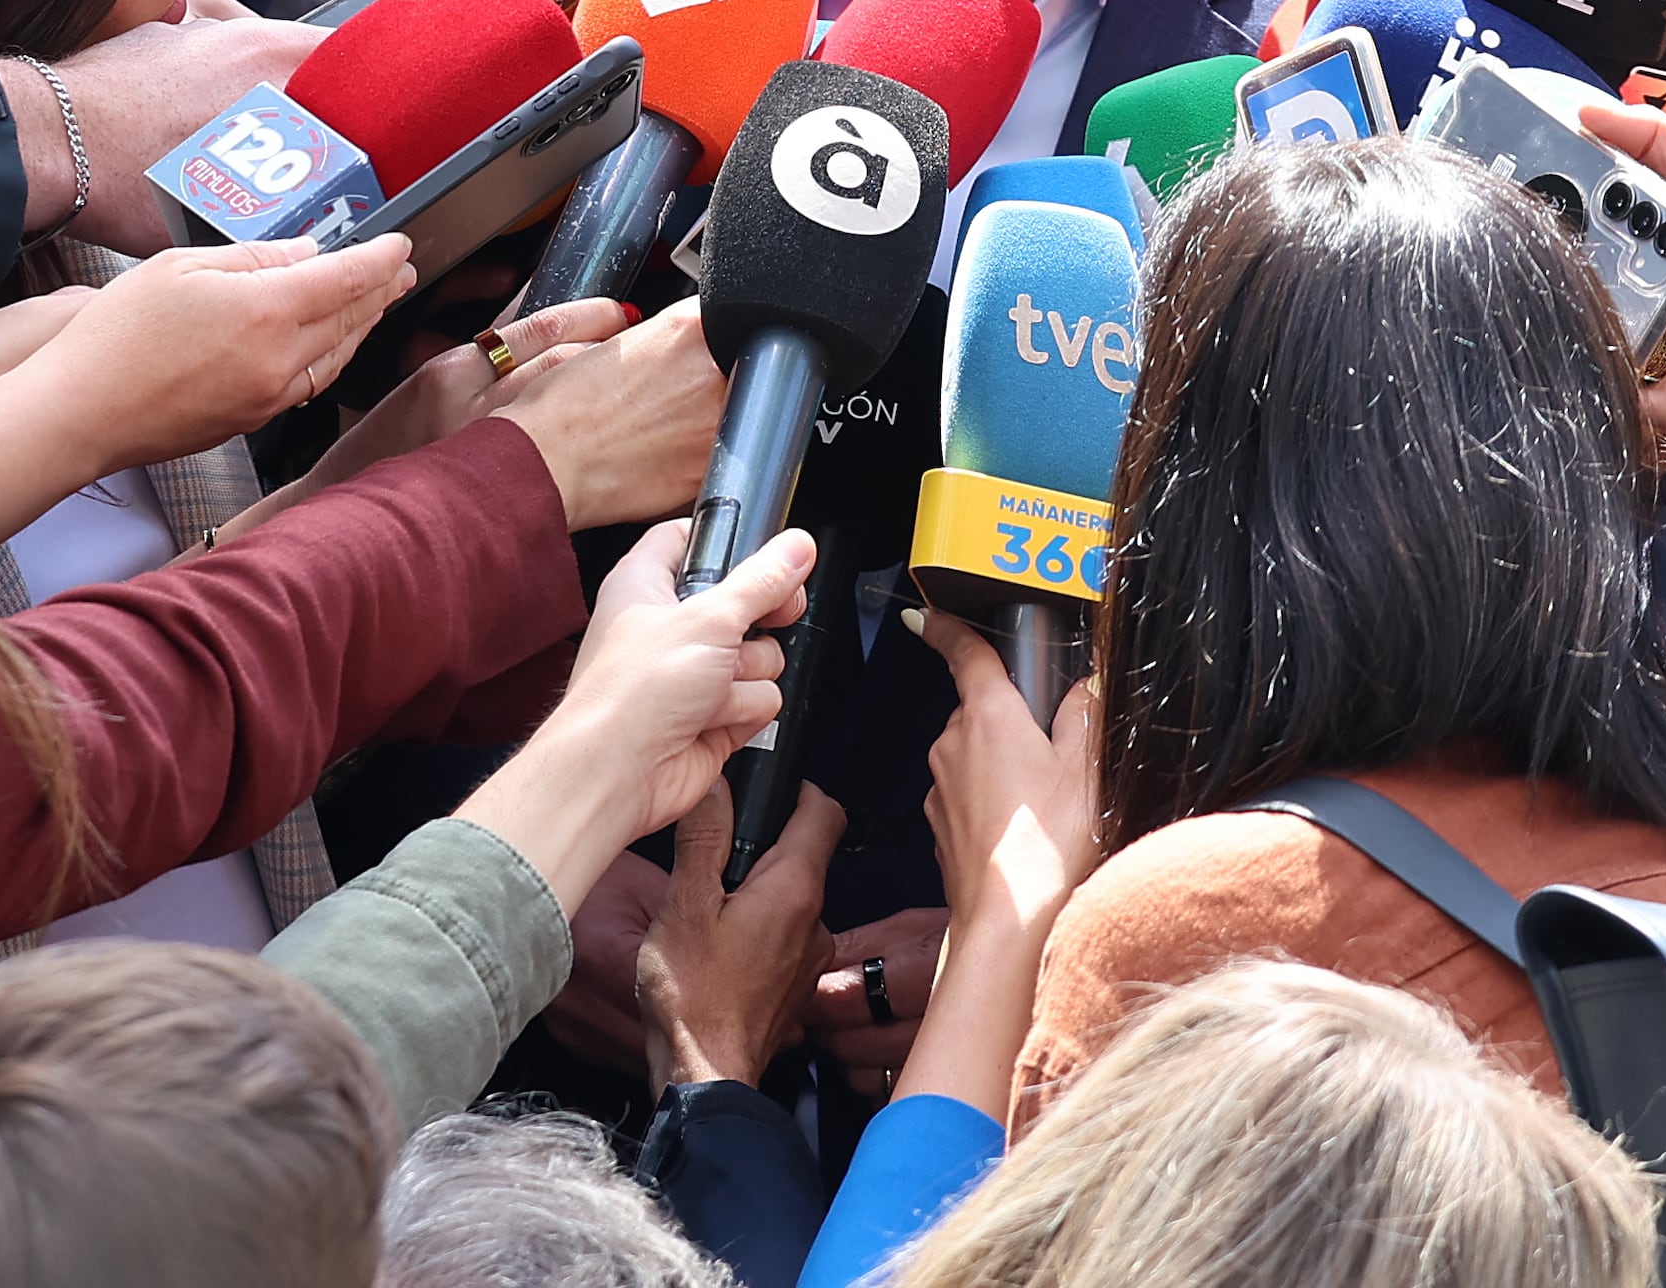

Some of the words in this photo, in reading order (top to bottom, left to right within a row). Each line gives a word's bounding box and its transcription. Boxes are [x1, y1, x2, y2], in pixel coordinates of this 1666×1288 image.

[185, 158, 262, 216] MINUTOS
[206, 113, 313, 195] 120
[1008, 293, 1135, 394] tve
